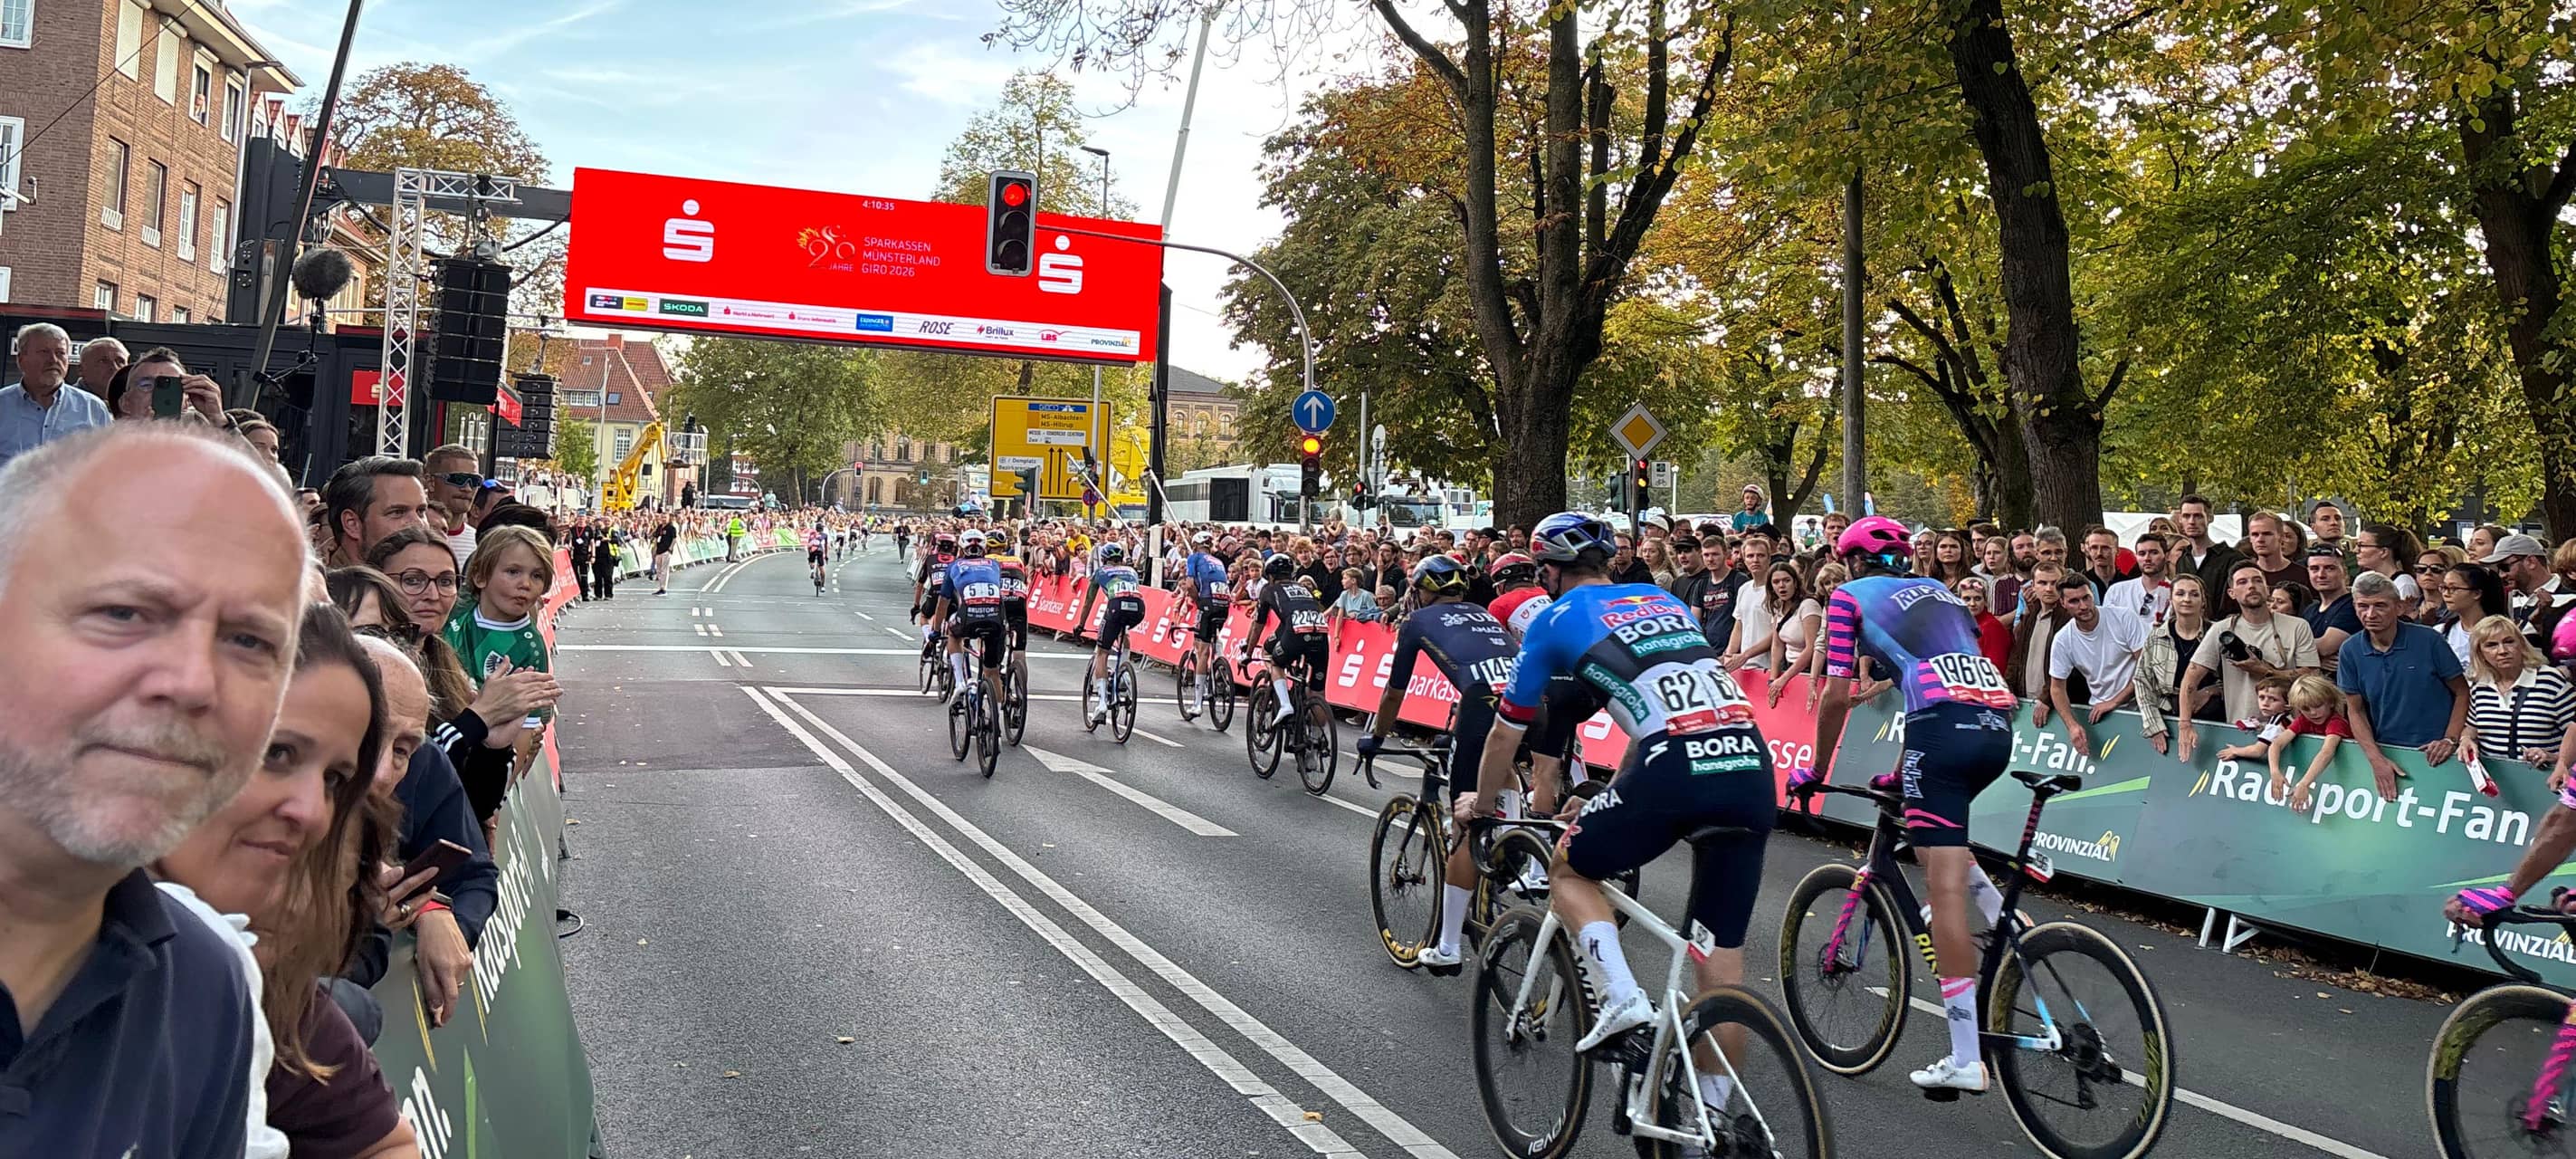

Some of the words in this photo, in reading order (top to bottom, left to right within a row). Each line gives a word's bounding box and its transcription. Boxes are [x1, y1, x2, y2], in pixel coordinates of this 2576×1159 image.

[862, 200, 895, 211] 4:10:35
[863, 236, 931, 252] SPARKASSEN
[863, 250, 940, 266] MÜNSTERLAND
[828, 263, 854, 272] JAHRE
[862, 263, 887, 275] GIRO
[890, 265, 915, 277] 2026
[919, 320, 954, 335] ROSE
[986, 326, 1015, 337] Brillux
[1041, 333, 1057, 341] LBS
[1091, 339, 1131, 348] PROVINZIAL
[968, 584, 976, 597] 5
[987, 584, 995, 596] 5
[1599, 607, 1650, 628] Red
[1614, 615, 1703, 645] BORA
[1932, 654, 1975, 689] 196
[1584, 663, 1647, 721] hansgrohe
[1658, 670, 1705, 713] 62
[1684, 735, 1760, 759] BORA
[1692, 755, 1760, 772] hansgrohe
